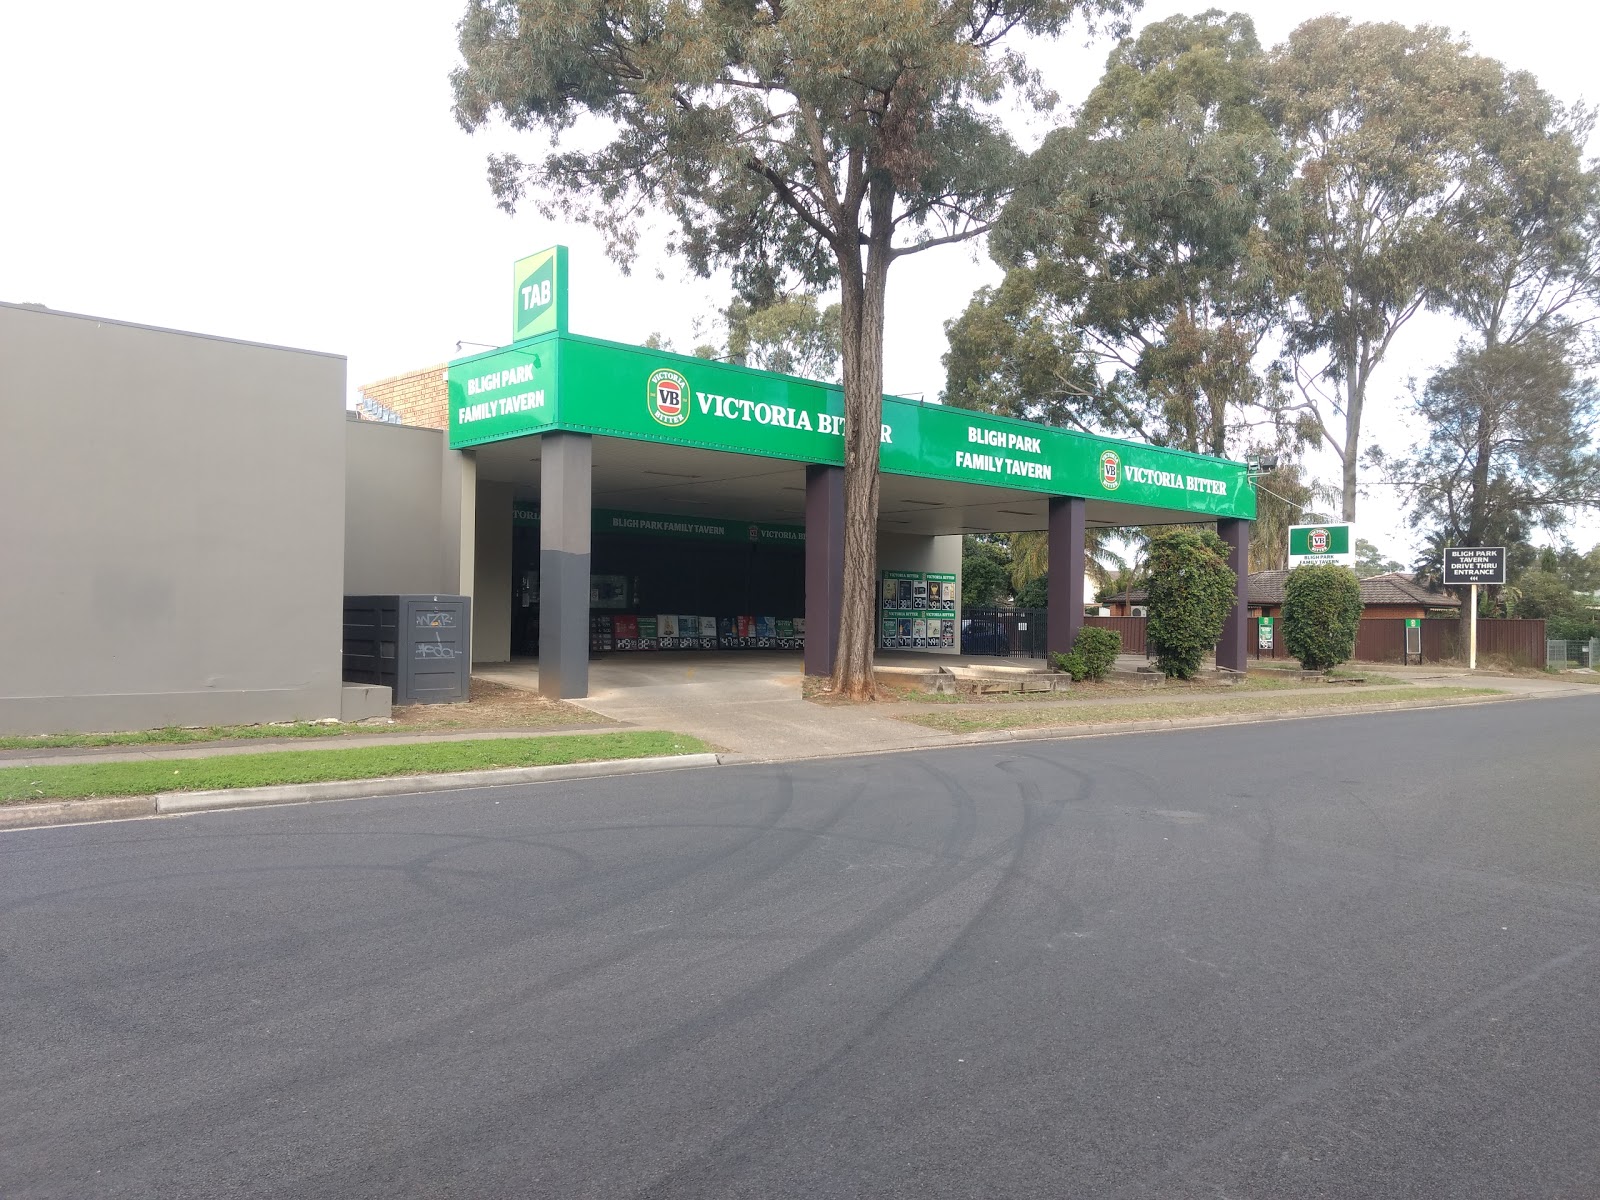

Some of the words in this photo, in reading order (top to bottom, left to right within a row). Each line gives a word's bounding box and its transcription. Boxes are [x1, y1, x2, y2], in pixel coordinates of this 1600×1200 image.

[522, 280, 551, 310] TAB
[468, 372, 500, 395] BLIGH
[502, 363, 534, 387] PARK
[652, 372, 686, 389] VICTORIA
[458, 400, 500, 424] FAMILY
[500, 390, 545, 414] TAVERN
[659, 389, 680, 405] VB
[696, 391, 813, 431] VICTORIA
[654, 410, 685, 423] BITTER
[968, 426, 1006, 448] BLIGH
[1008, 433, 1041, 454] PARK
[955, 450, 1003, 472] FAMILY
[1005, 458, 1052, 480] TAVERN
[1105, 464, 1116, 475] VB
[1124, 465, 1184, 489] VICTORIA
[1186, 475, 1227, 495] BITTER
[612, 517, 639, 528] BLIGH
[640, 520, 663, 530] PARK
[664, 522, 693, 532] FAMILY
[694, 525, 725, 535] TAVERN
[760, 530, 797, 540] VICTORIA
